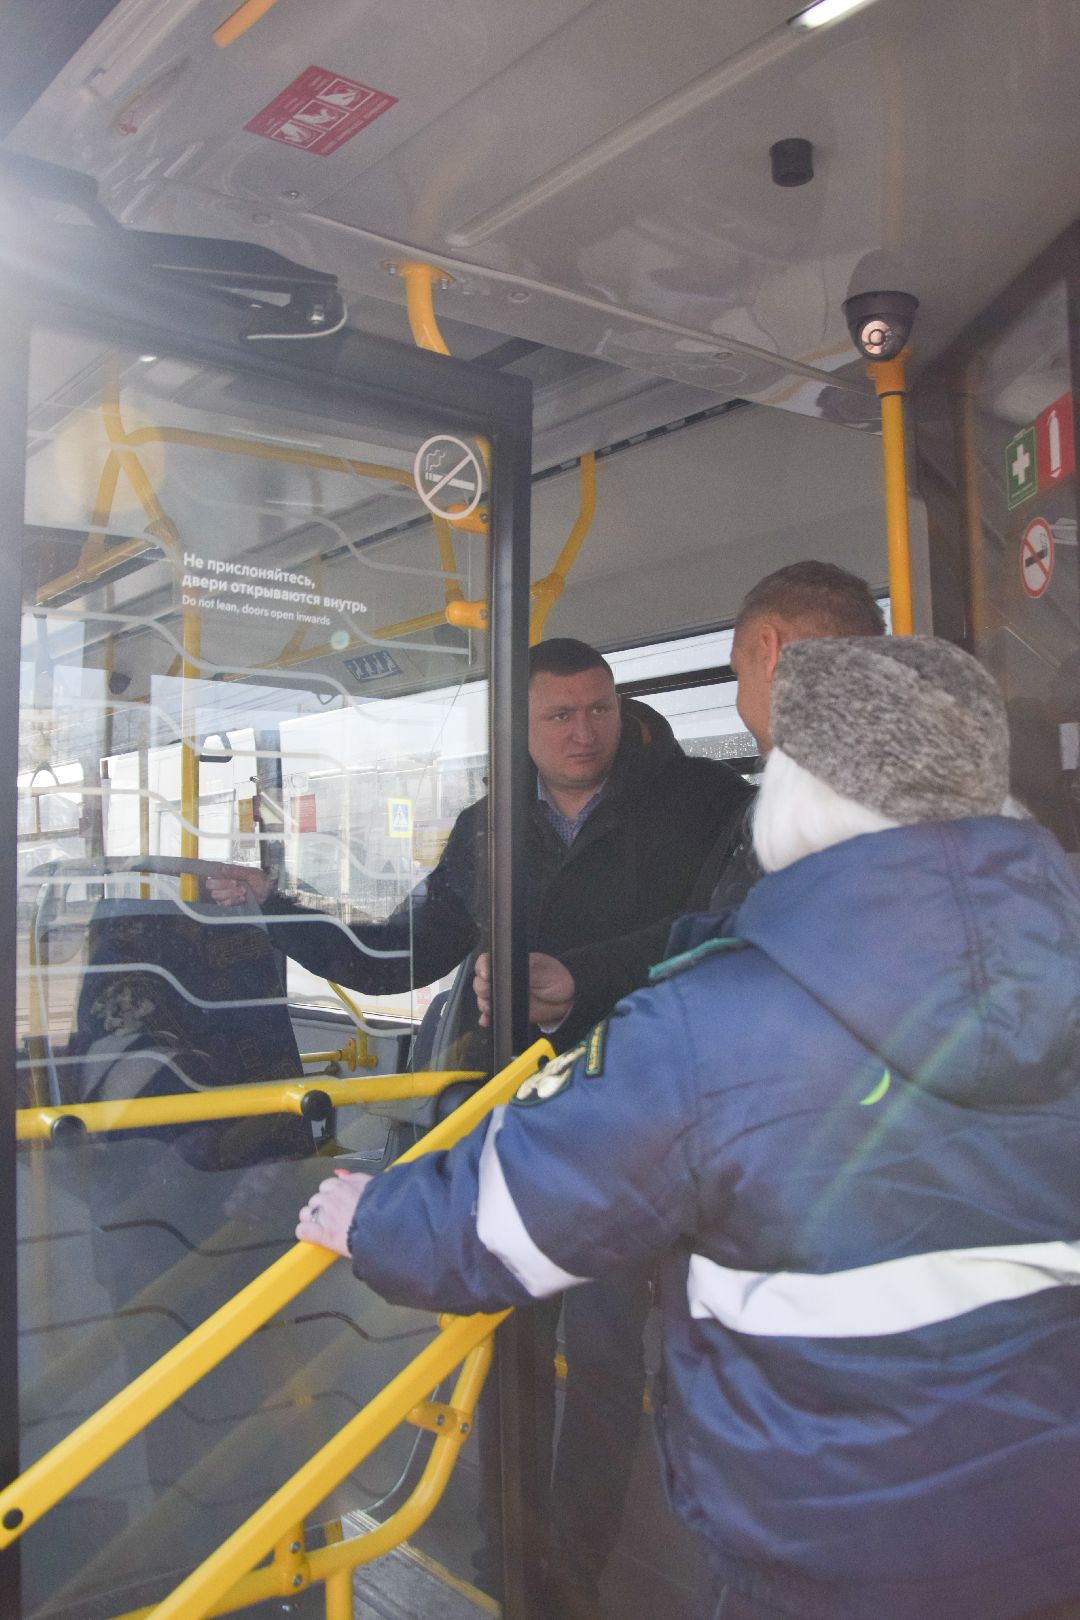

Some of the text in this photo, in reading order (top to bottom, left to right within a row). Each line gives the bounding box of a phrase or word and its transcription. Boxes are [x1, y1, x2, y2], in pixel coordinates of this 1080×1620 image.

[183, 552, 316, 590] Не прислоняйтесь,
[182, 574, 368, 614] двери открываются внутрь
[182, 594, 331, 626] Do not lean, doors open inwards
